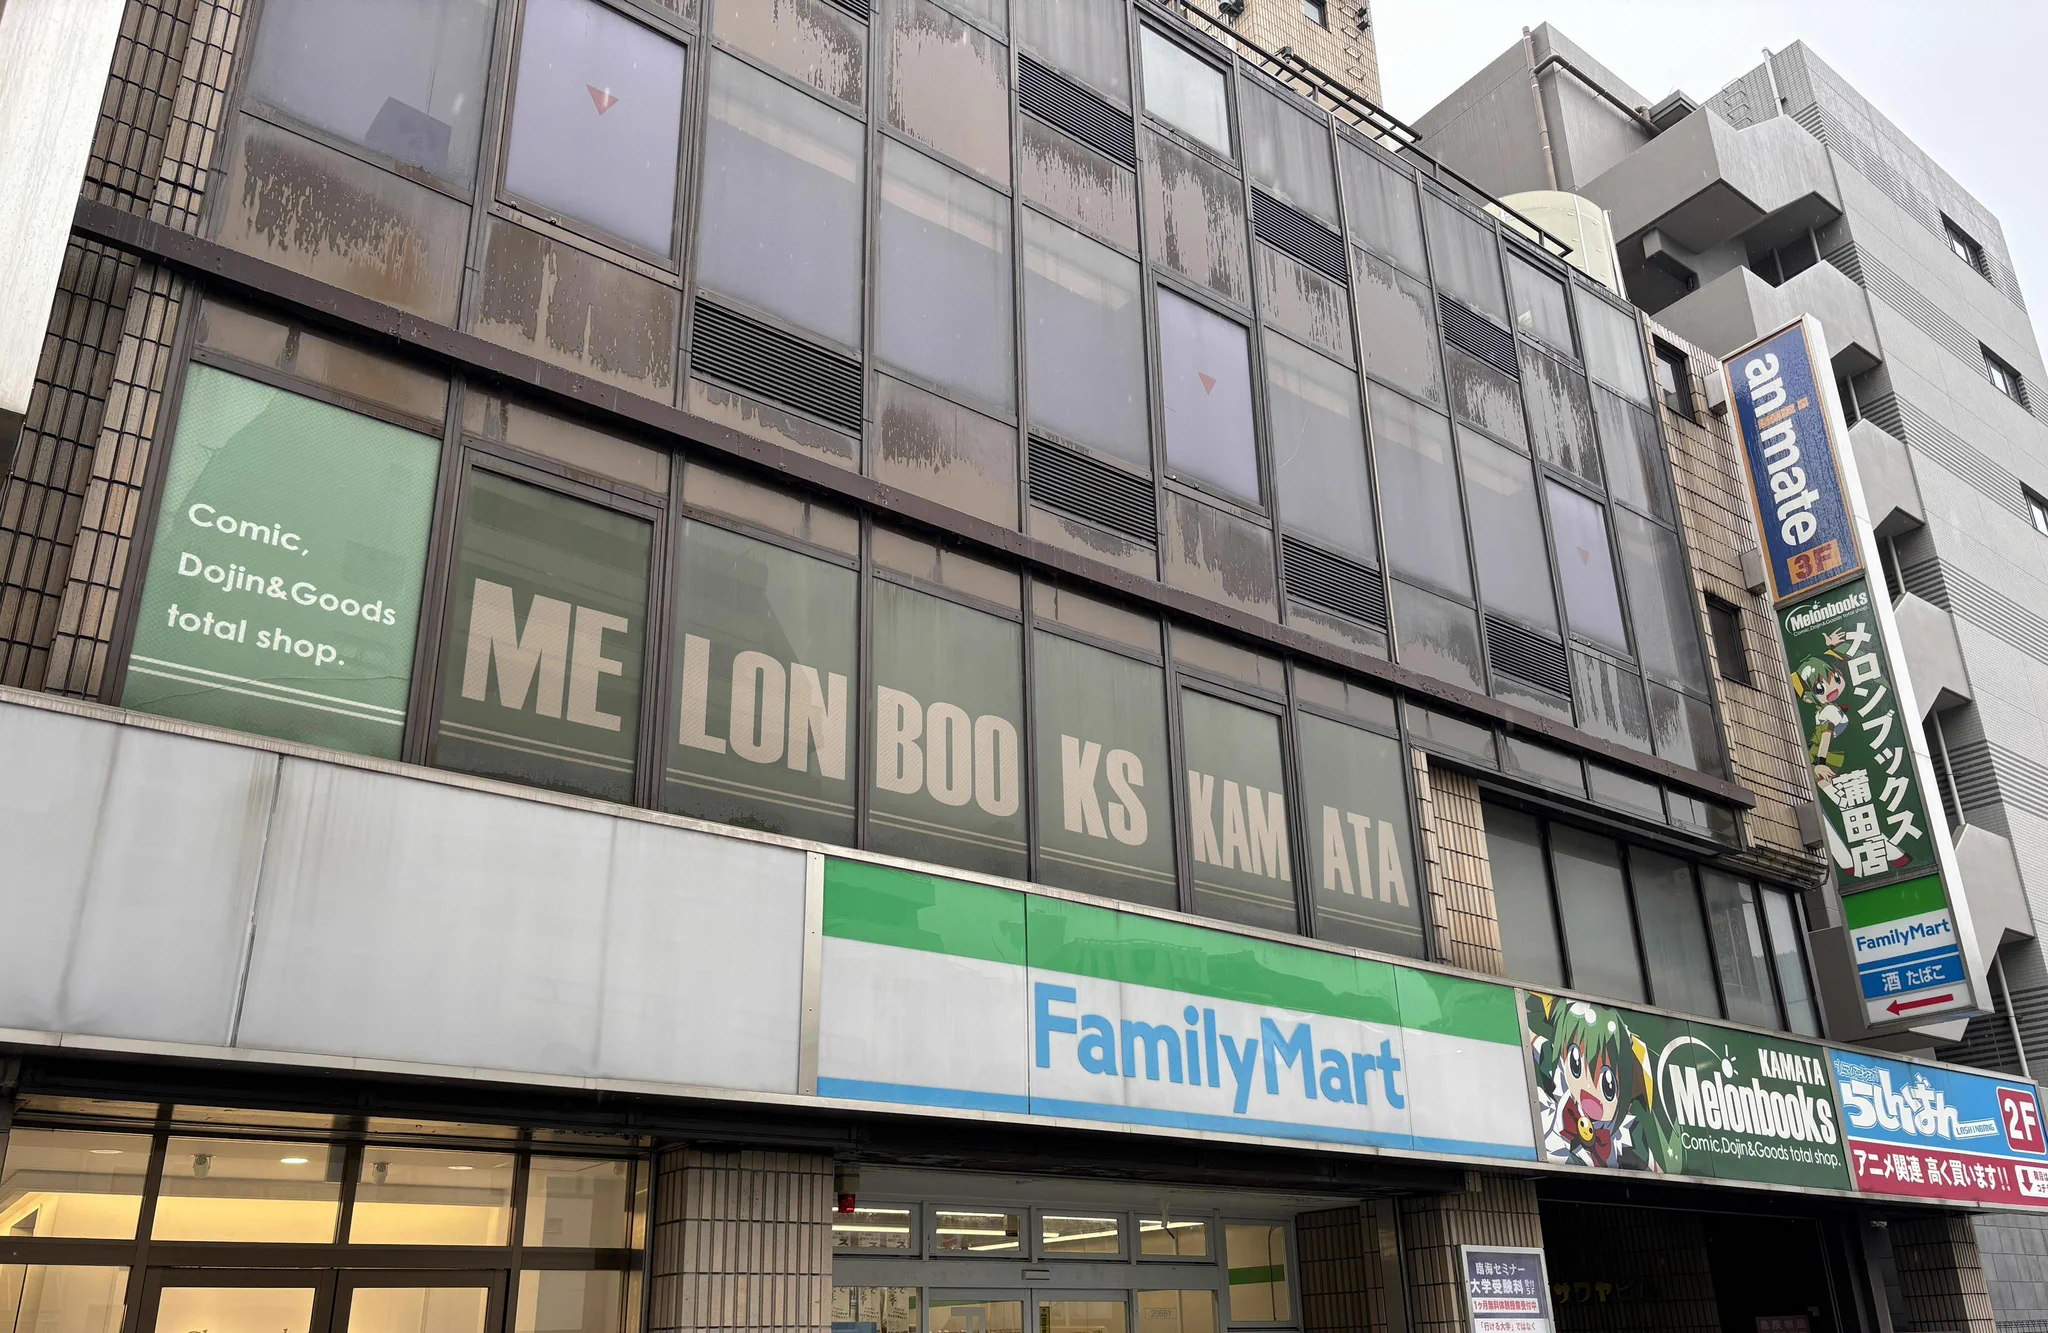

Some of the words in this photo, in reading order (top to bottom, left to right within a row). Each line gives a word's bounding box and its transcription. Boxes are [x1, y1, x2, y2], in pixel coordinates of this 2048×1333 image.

[1744, 352, 1821, 547] animate
[187, 502, 310, 557] Comic,
[1793, 543, 1836, 581] 3F
[177, 551, 397, 627] Dojin&Goods
[1789, 591, 1868, 632] Melonbooks
[166, 602, 247, 646] total
[255, 625, 346, 667] shop.
[1845, 622, 1923, 847] メロンブックス
[1832, 768, 1889, 879] 蒲田店
[1855, 918, 1951, 952] FamilyMart
[1881, 970, 1902, 992] 酒
[1906, 964, 1946, 986] たばこ
[1033, 981, 1406, 1114] FamilyMart
[1757, 1047, 1826, 1087] KAMATA
[1668, 1063, 1837, 1146] Melonbooks
[1839, 1068, 1959, 1141] らしんばん
[2003, 1097, 2038, 1142] 2F
[1790, 1145, 1814, 1164] total
[1853, 1148, 1925, 1185] アニメ関連
[1470, 1278, 1524, 1295] 大学受験科
[1475, 1261, 1526, 1276] 臨海セミナー
